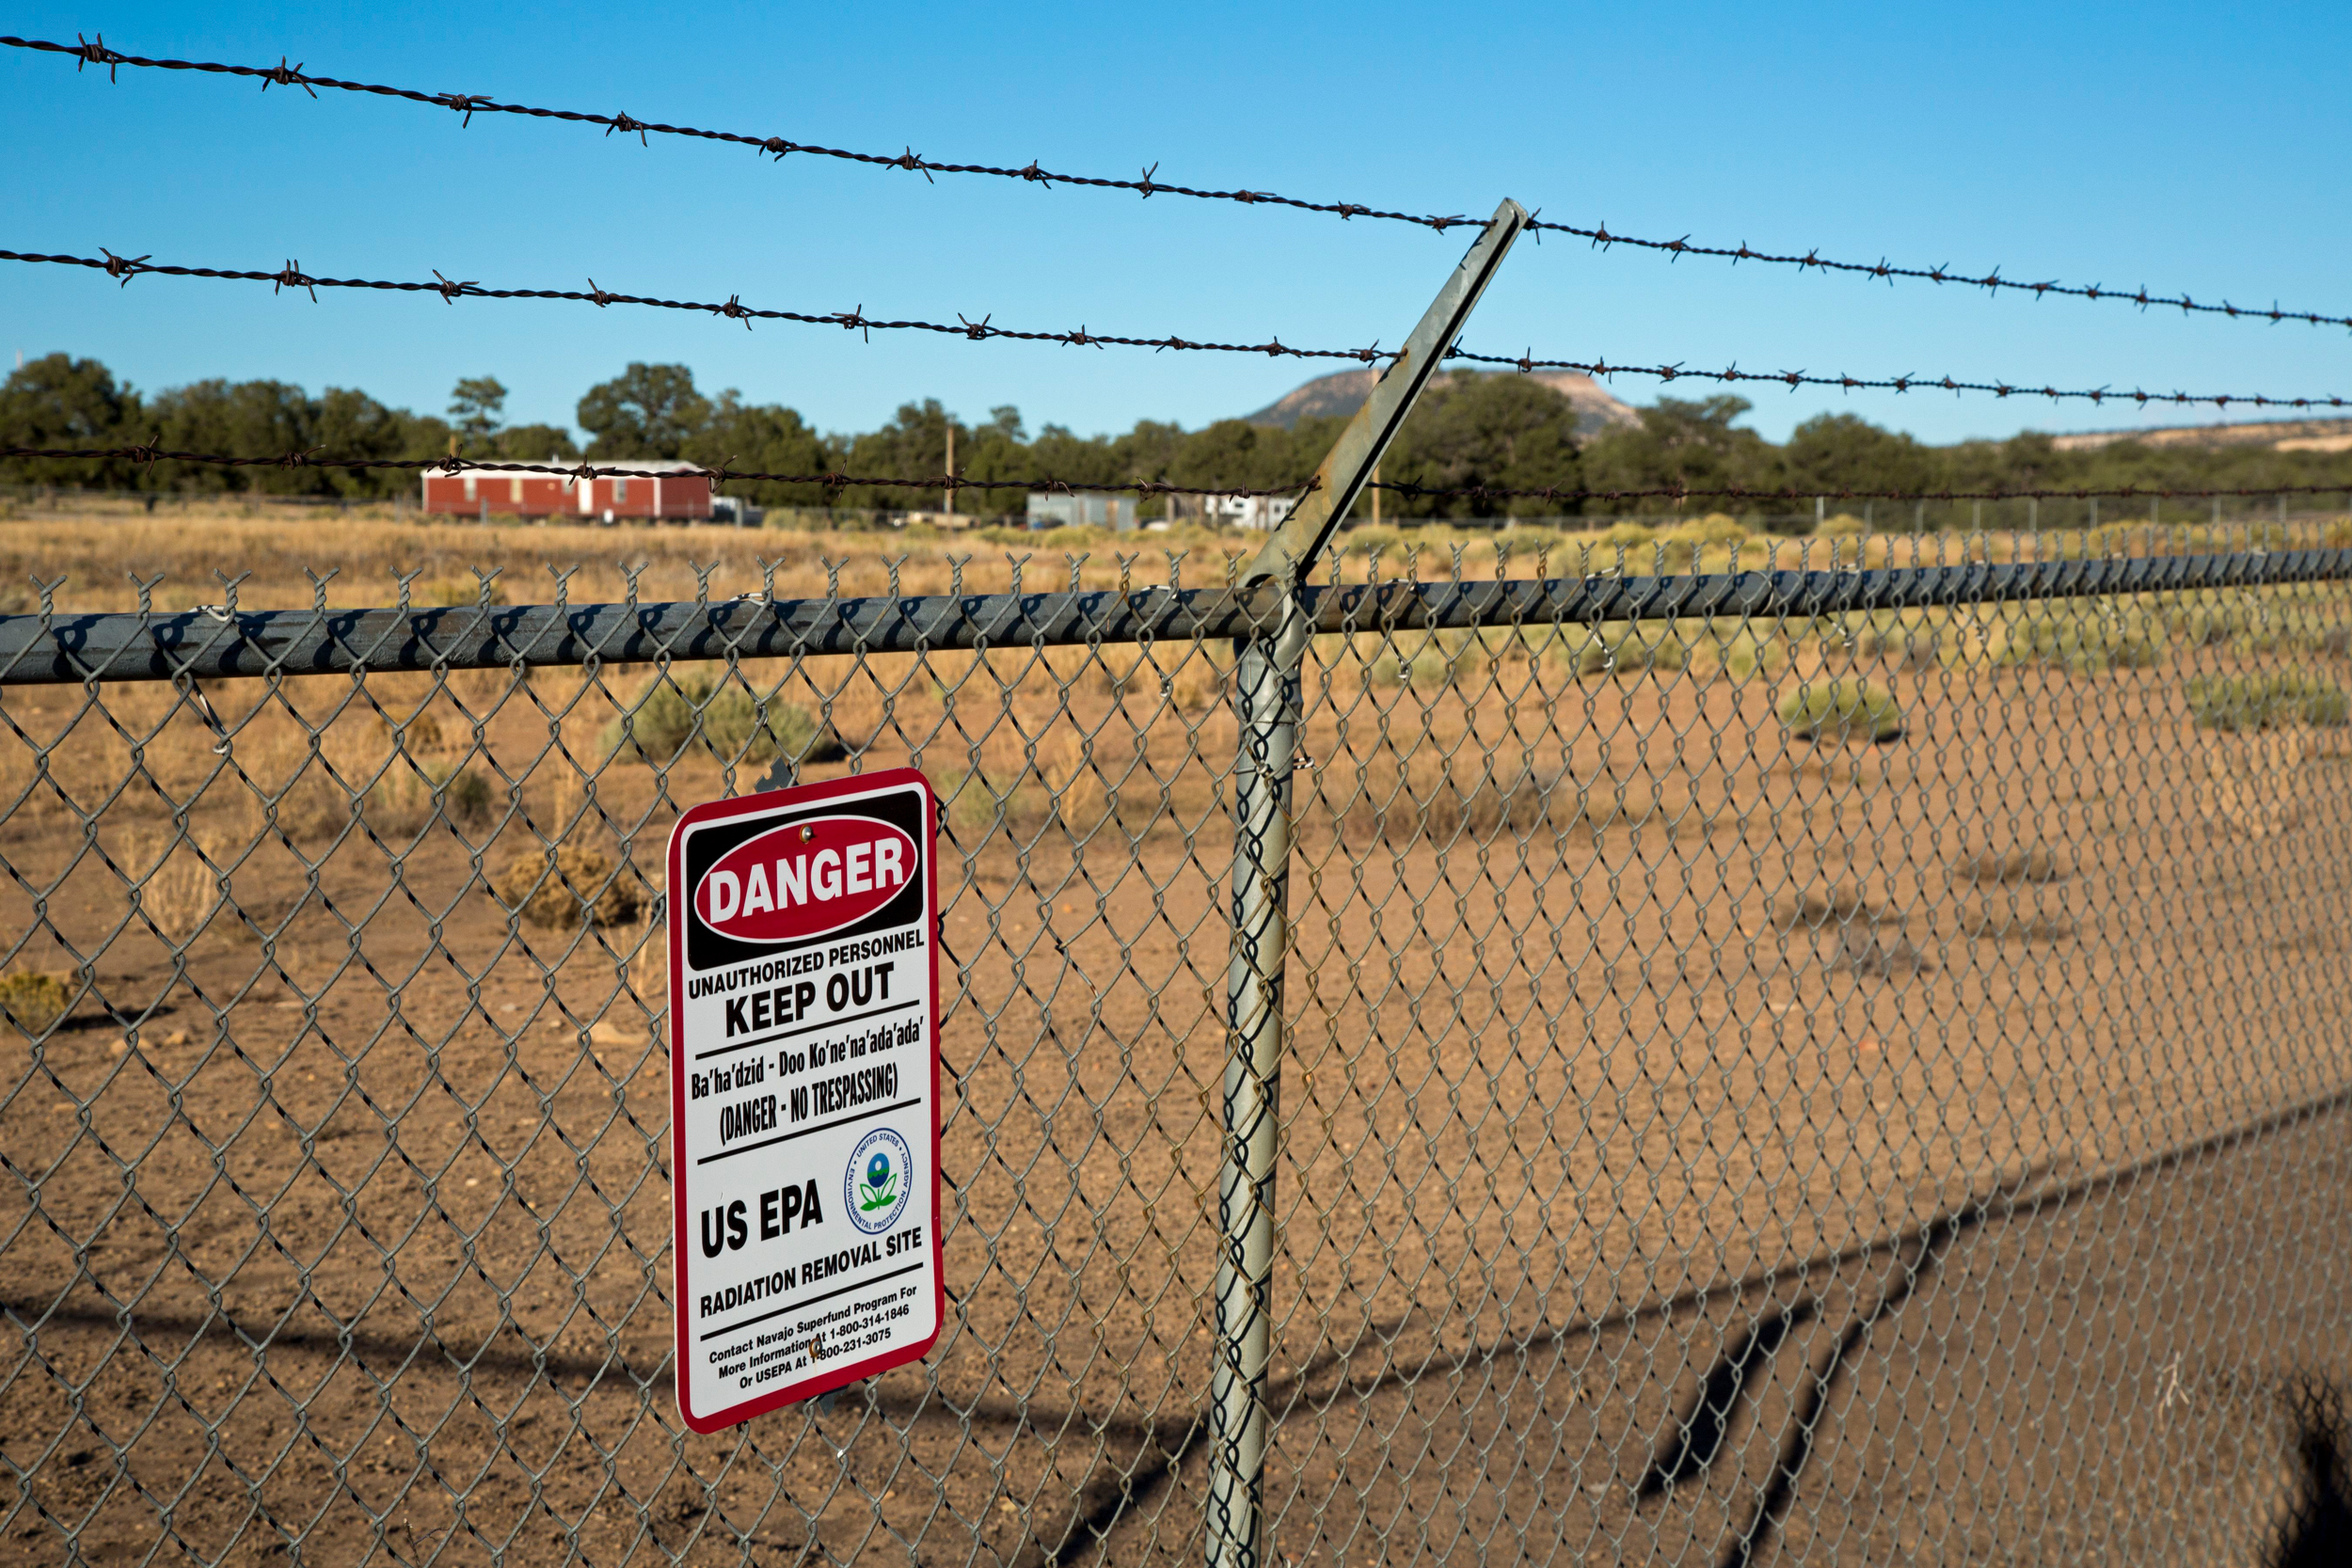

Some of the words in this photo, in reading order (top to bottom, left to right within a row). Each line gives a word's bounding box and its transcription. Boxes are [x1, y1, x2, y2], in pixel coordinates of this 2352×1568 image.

[709, 837, 904, 925] DANGER
[689, 952, 824, 1000] UNAUTHORIZED
[829, 928, 925, 967] PERSONNEL
[725, 981, 816, 1038] KEEP
[826, 961, 895, 1012] OUT
[779, 1051, 805, 1077] Doo
[720, 1094, 777, 1147] (DANGER
[791, 1085, 808, 1123] NO
[812, 1062, 898, 1117] TRESPASSING)
[856, 1134, 878, 1158] UNITED
[879, 1132, 899, 1148] STATES
[701, 1199, 748, 1259] US
[760, 1178, 824, 1242] EPA
[848, 1167, 872, 1230] ENVIRONMENTAL
[873, 1190, 907, 1230] PROTECTION
[900, 1152, 910, 1188] AGENCY
[700, 1267, 797, 1319] RADIATION
[802, 1241, 882, 1285] REMOVAL
[886, 1226, 923, 1258] SITE
[708, 1340, 754, 1364] Contact
[756, 1326, 794, 1349] Navajo
[797, 1305, 850, 1334] Superfund
[853, 1292, 898, 1315] Program
[900, 1285, 917, 1300] For
[719, 1363, 746, 1380] More
[749, 1338, 811, 1368] Information
[830, 1304, 909, 1340] 1-800-314-1846
[739, 1376, 753, 1389] Or
[755, 1360, 792, 1384] USEPA
[795, 1354, 807, 1370] At
